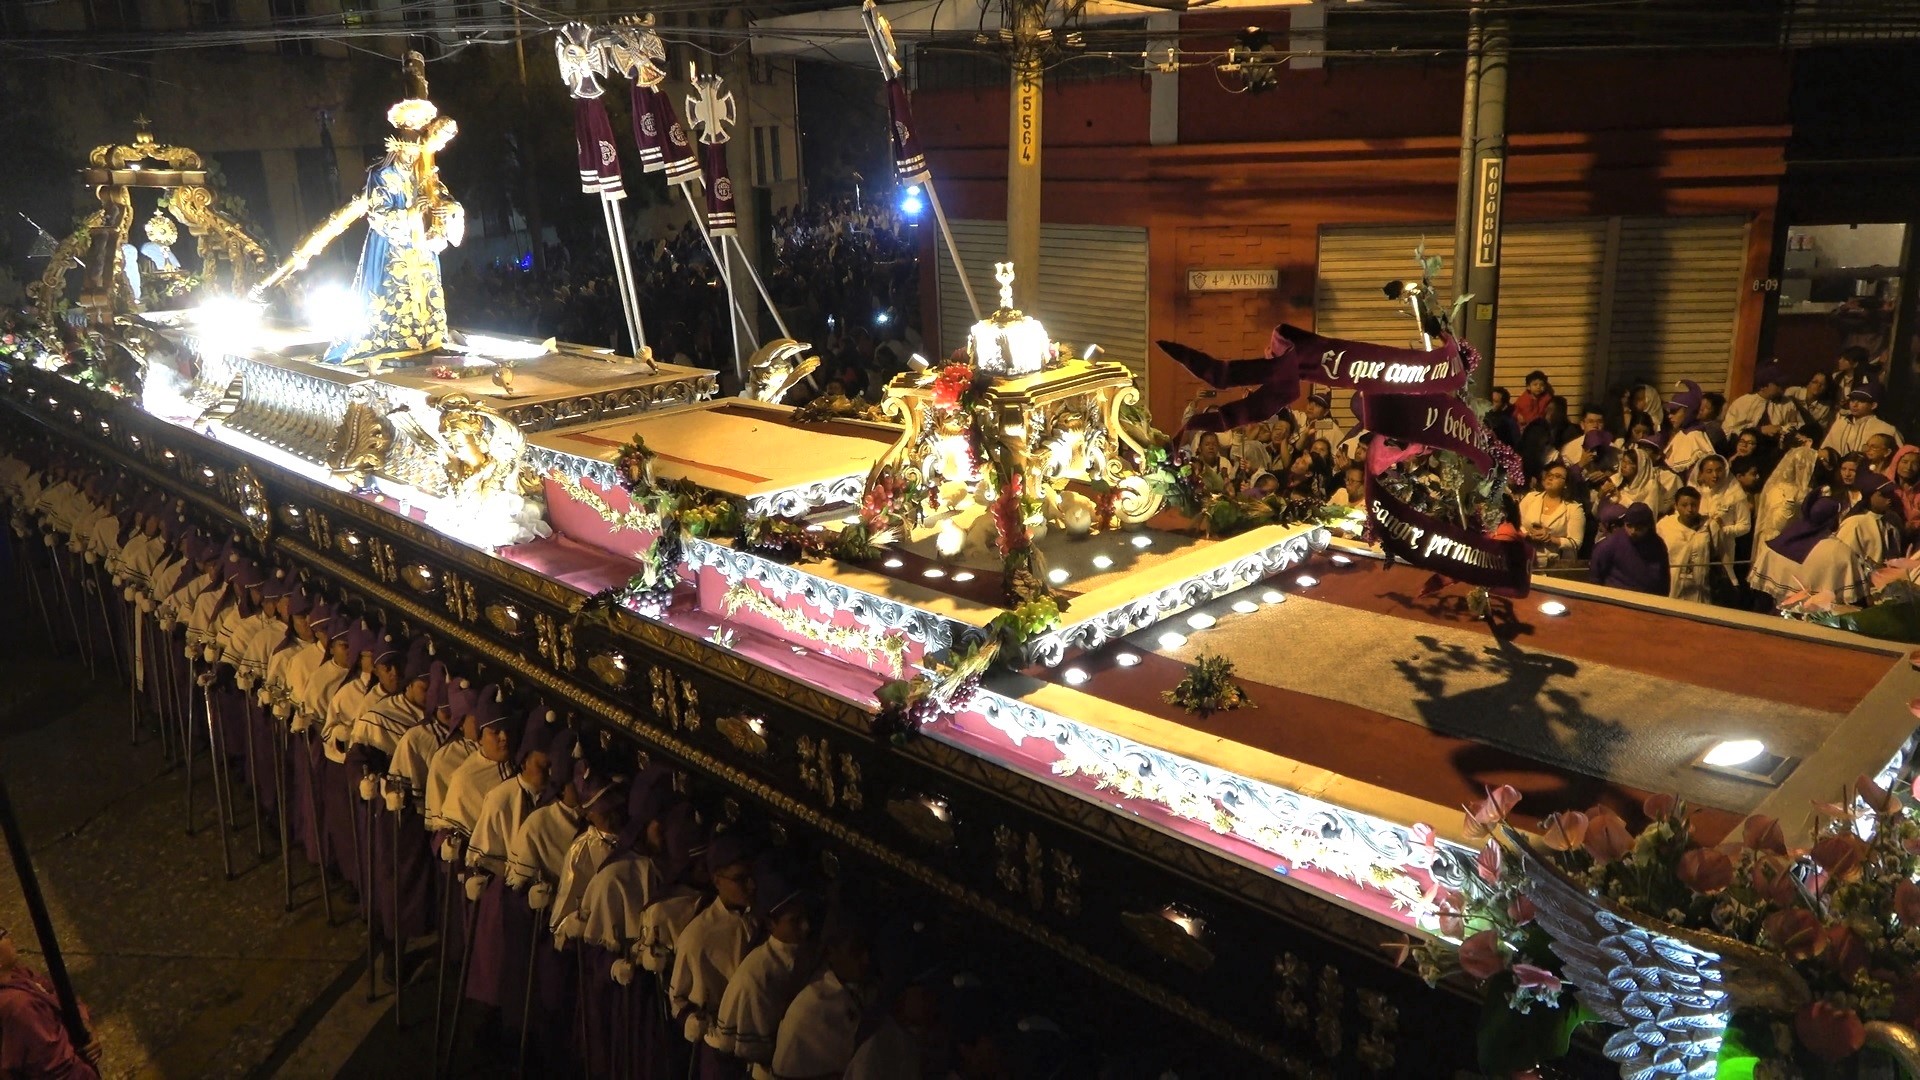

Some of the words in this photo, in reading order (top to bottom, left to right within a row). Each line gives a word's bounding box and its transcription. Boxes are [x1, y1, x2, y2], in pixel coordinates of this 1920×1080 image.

[1229, 273, 1275, 286] AVENIDA
[1321, 350, 1346, 380] El
[1349, 360, 1385, 384] que
[1385, 362, 1430, 383] come
[1422, 407, 1439, 431] y
[1443, 407, 1472, 445] bebe
[1371, 500, 1425, 549] sangre
